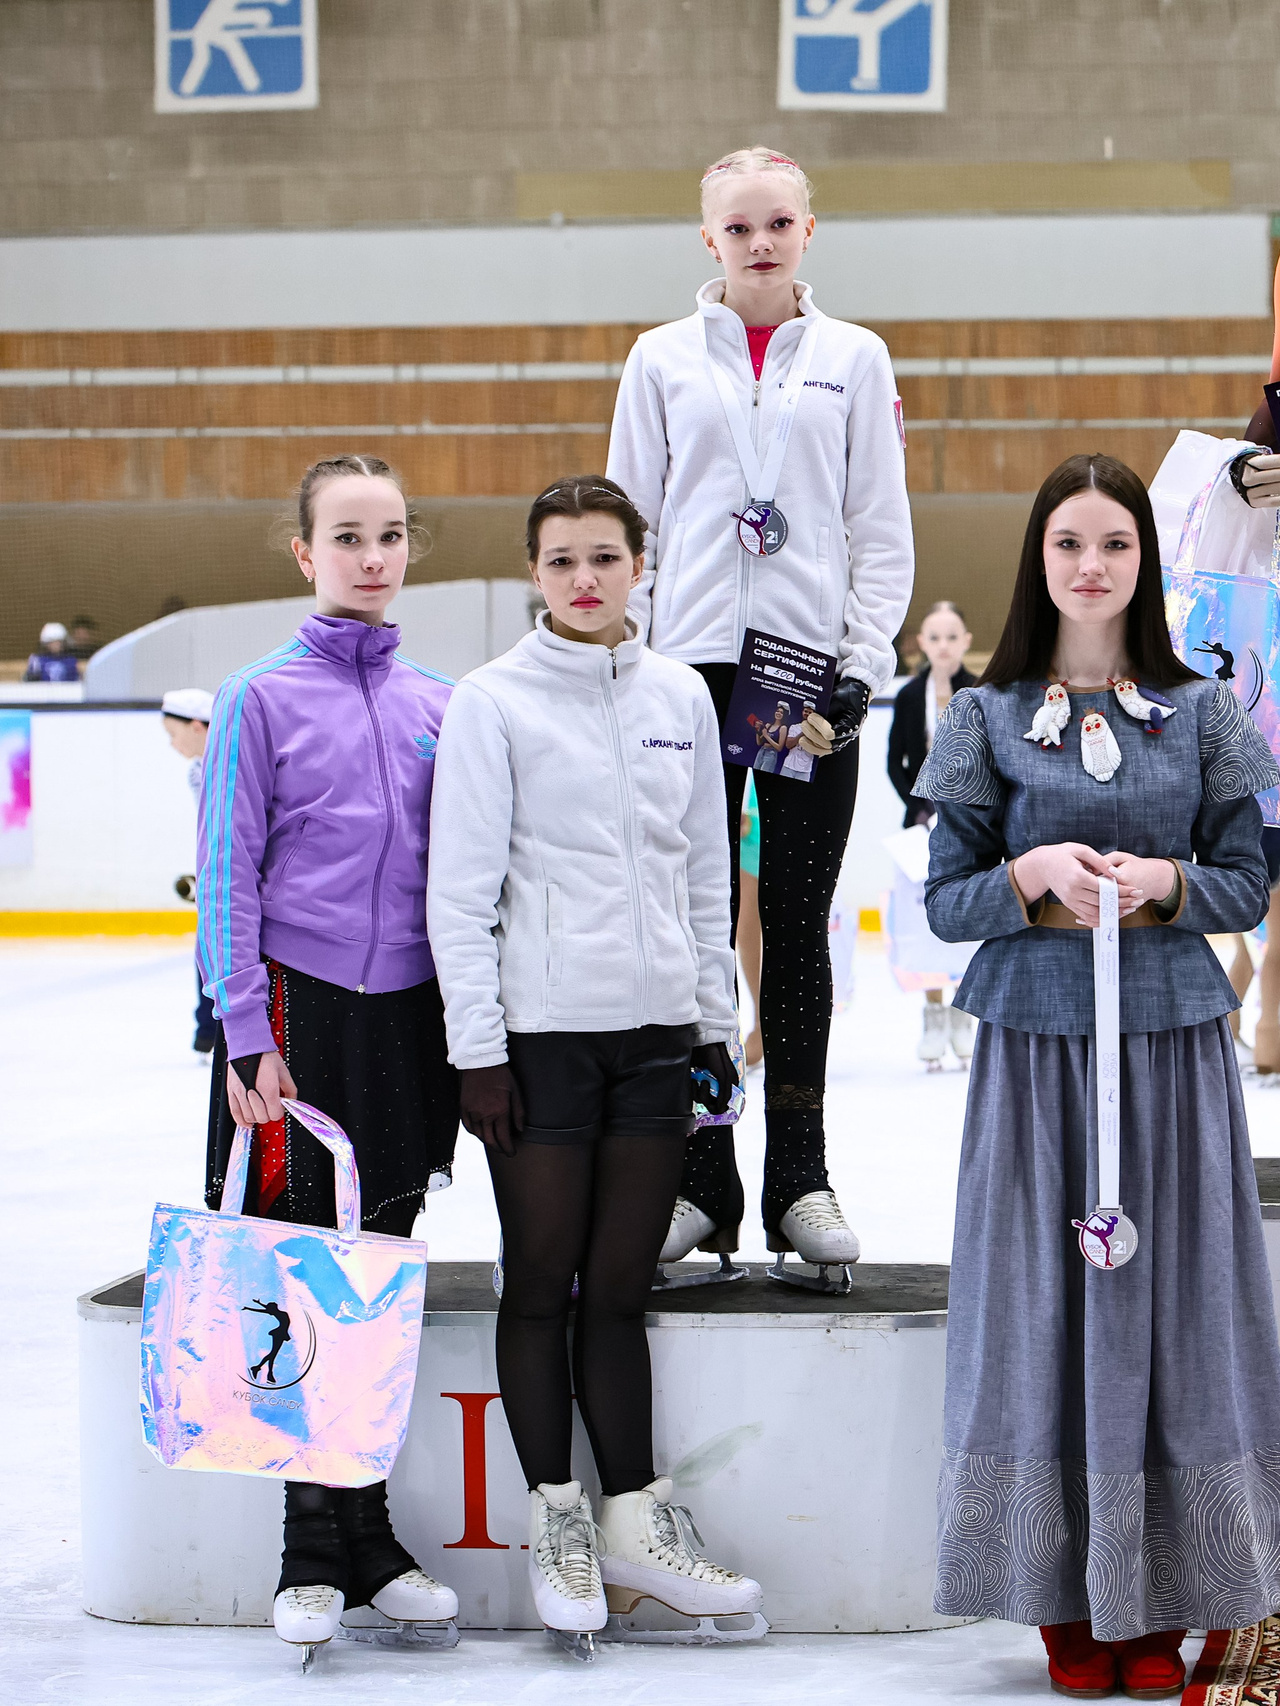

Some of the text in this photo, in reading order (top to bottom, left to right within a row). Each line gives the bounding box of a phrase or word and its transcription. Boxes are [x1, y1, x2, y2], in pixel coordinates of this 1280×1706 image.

[803, 380, 845, 394] АНГЕЛЬСК
[766, 531, 775, 544] 2
[753, 648, 824, 677] СЕРТИФИКАТ
[754, 637, 828, 668] ПОДАРОЧНЫЙ
[750, 663, 824, 692] На 500 рублей
[1113, 1240, 1123, 1255] 2
[232, 1390, 302, 1411] КУБОК CANDY
